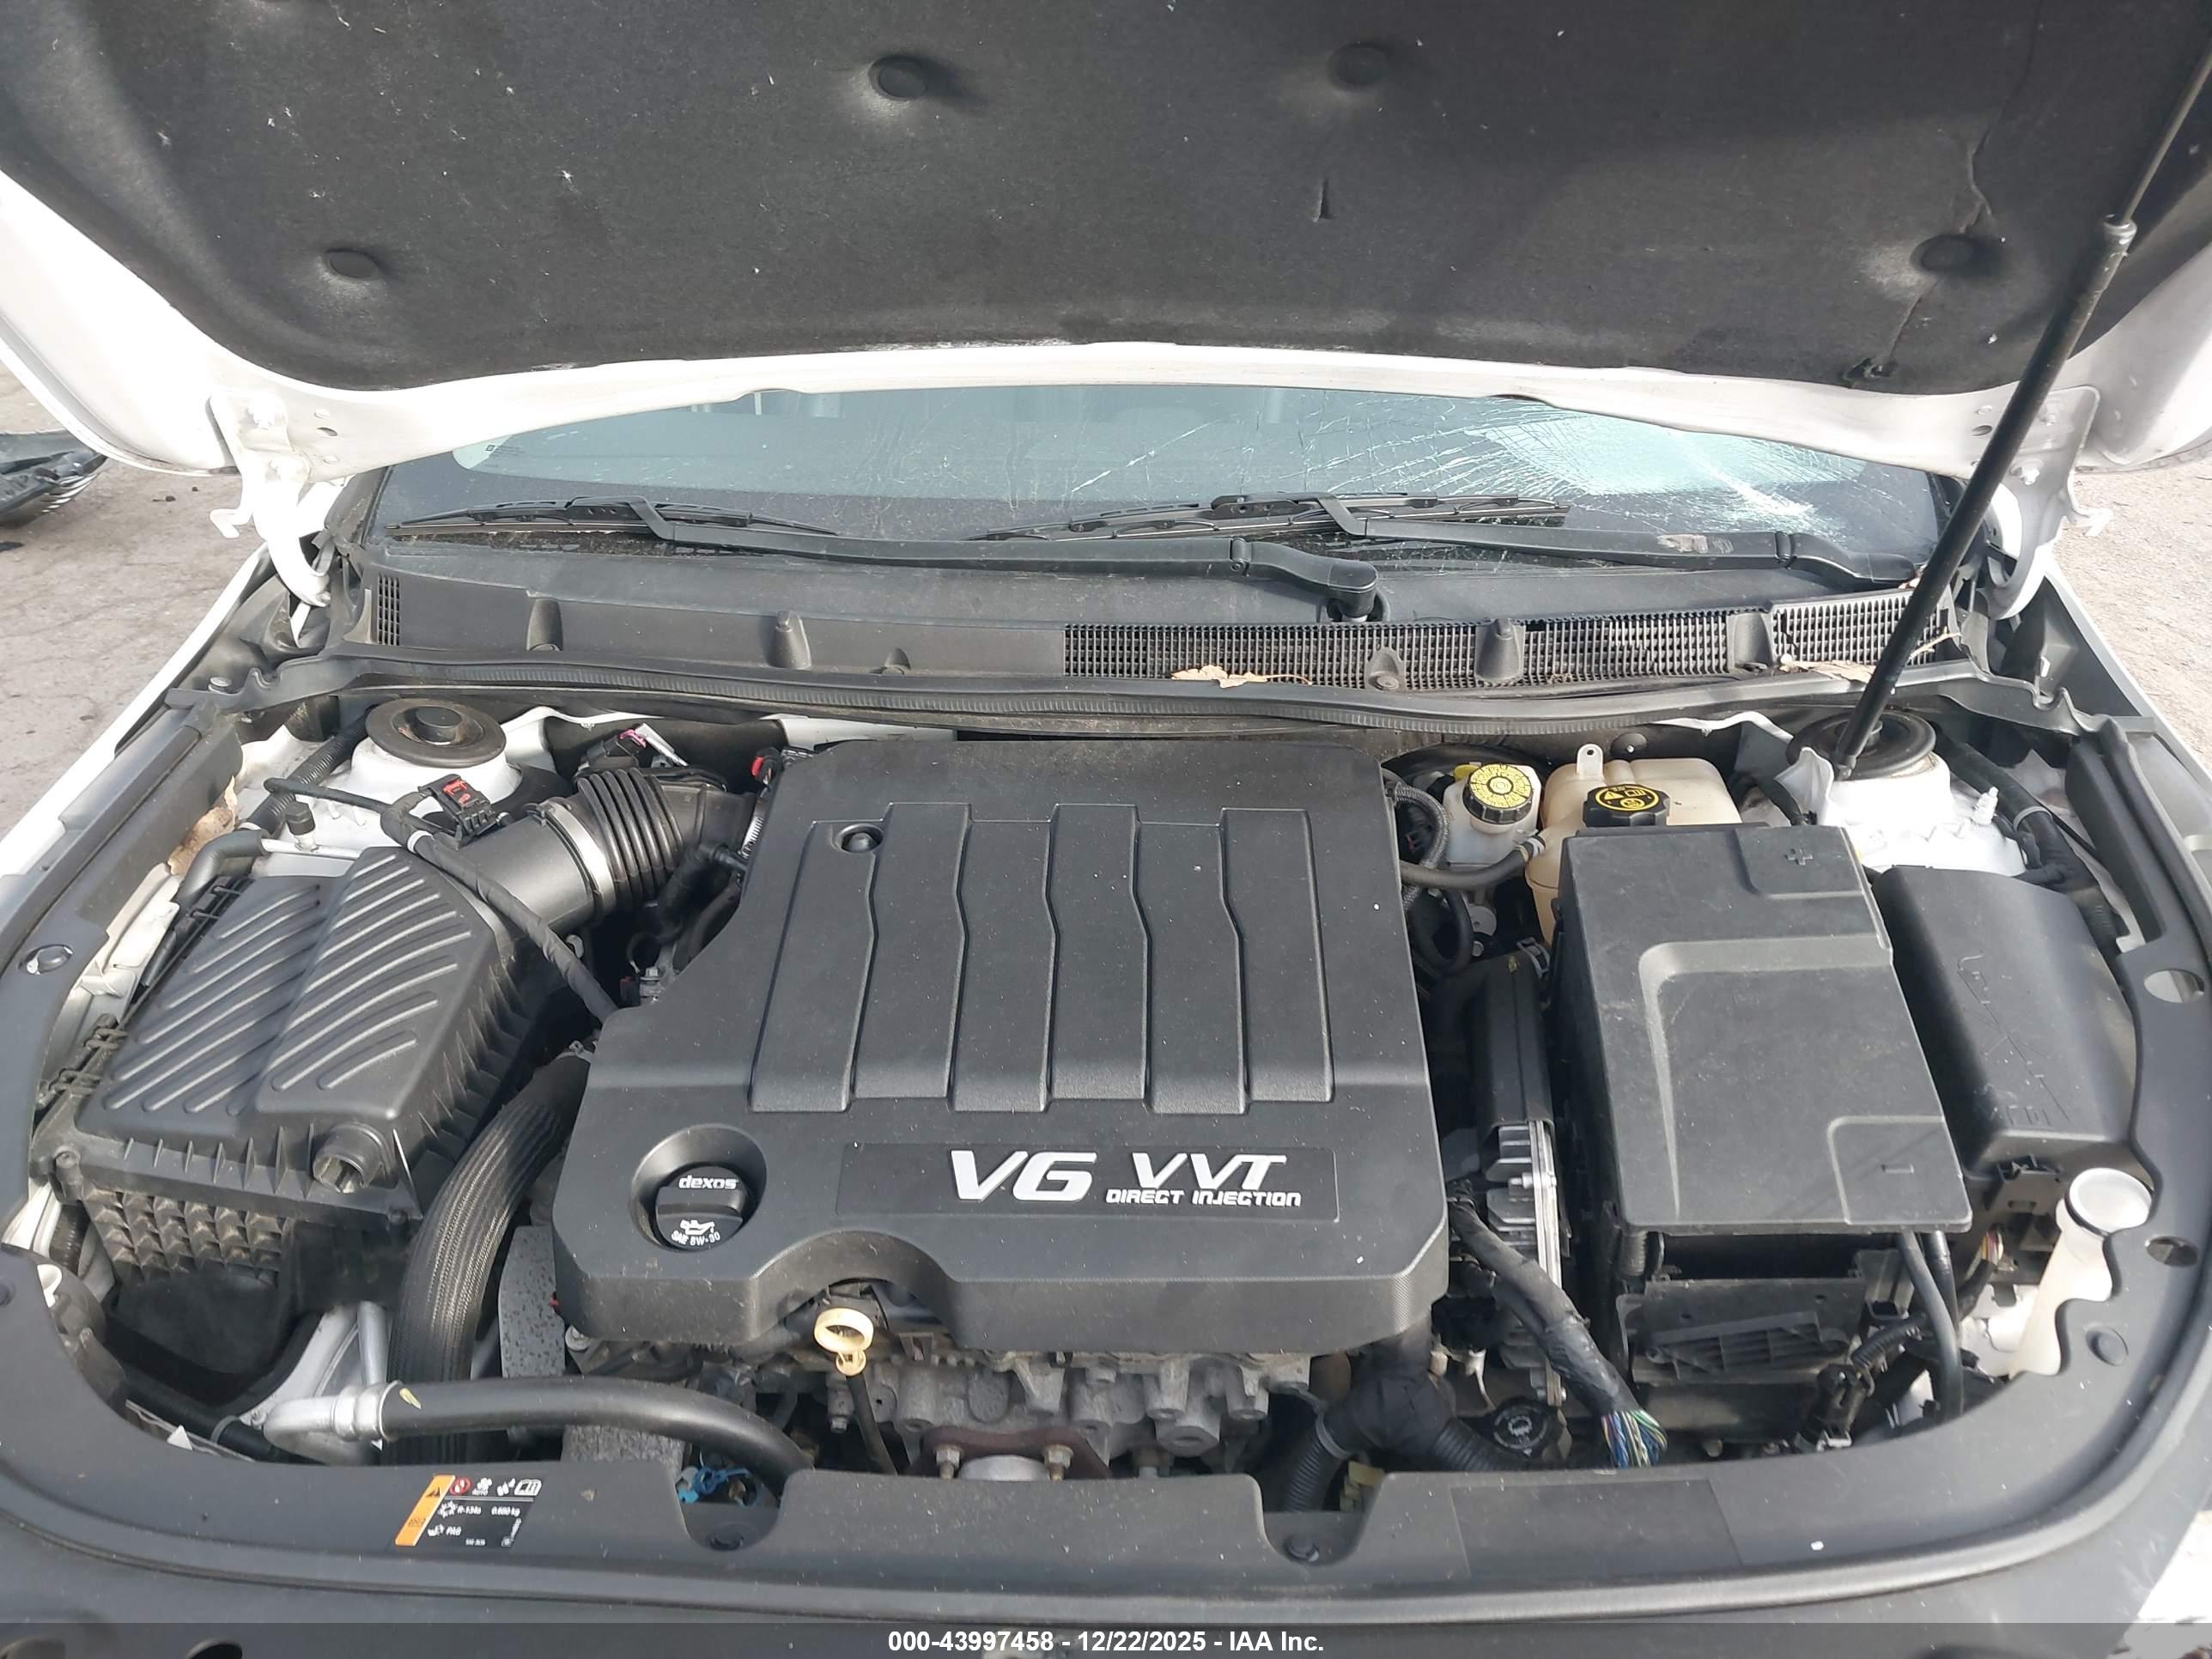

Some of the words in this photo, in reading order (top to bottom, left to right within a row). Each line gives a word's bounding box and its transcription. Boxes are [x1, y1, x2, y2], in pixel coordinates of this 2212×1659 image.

[678, 1175, 738, 1190] dexos
[951, 1150, 1097, 1202] V6
[1131, 1152, 1287, 1191] VVT
[1105, 1188, 1185, 1205] DIRECT
[1191, 1190, 1302, 1207] INJECTION
[672, 1230, 689, 1245] SAE
